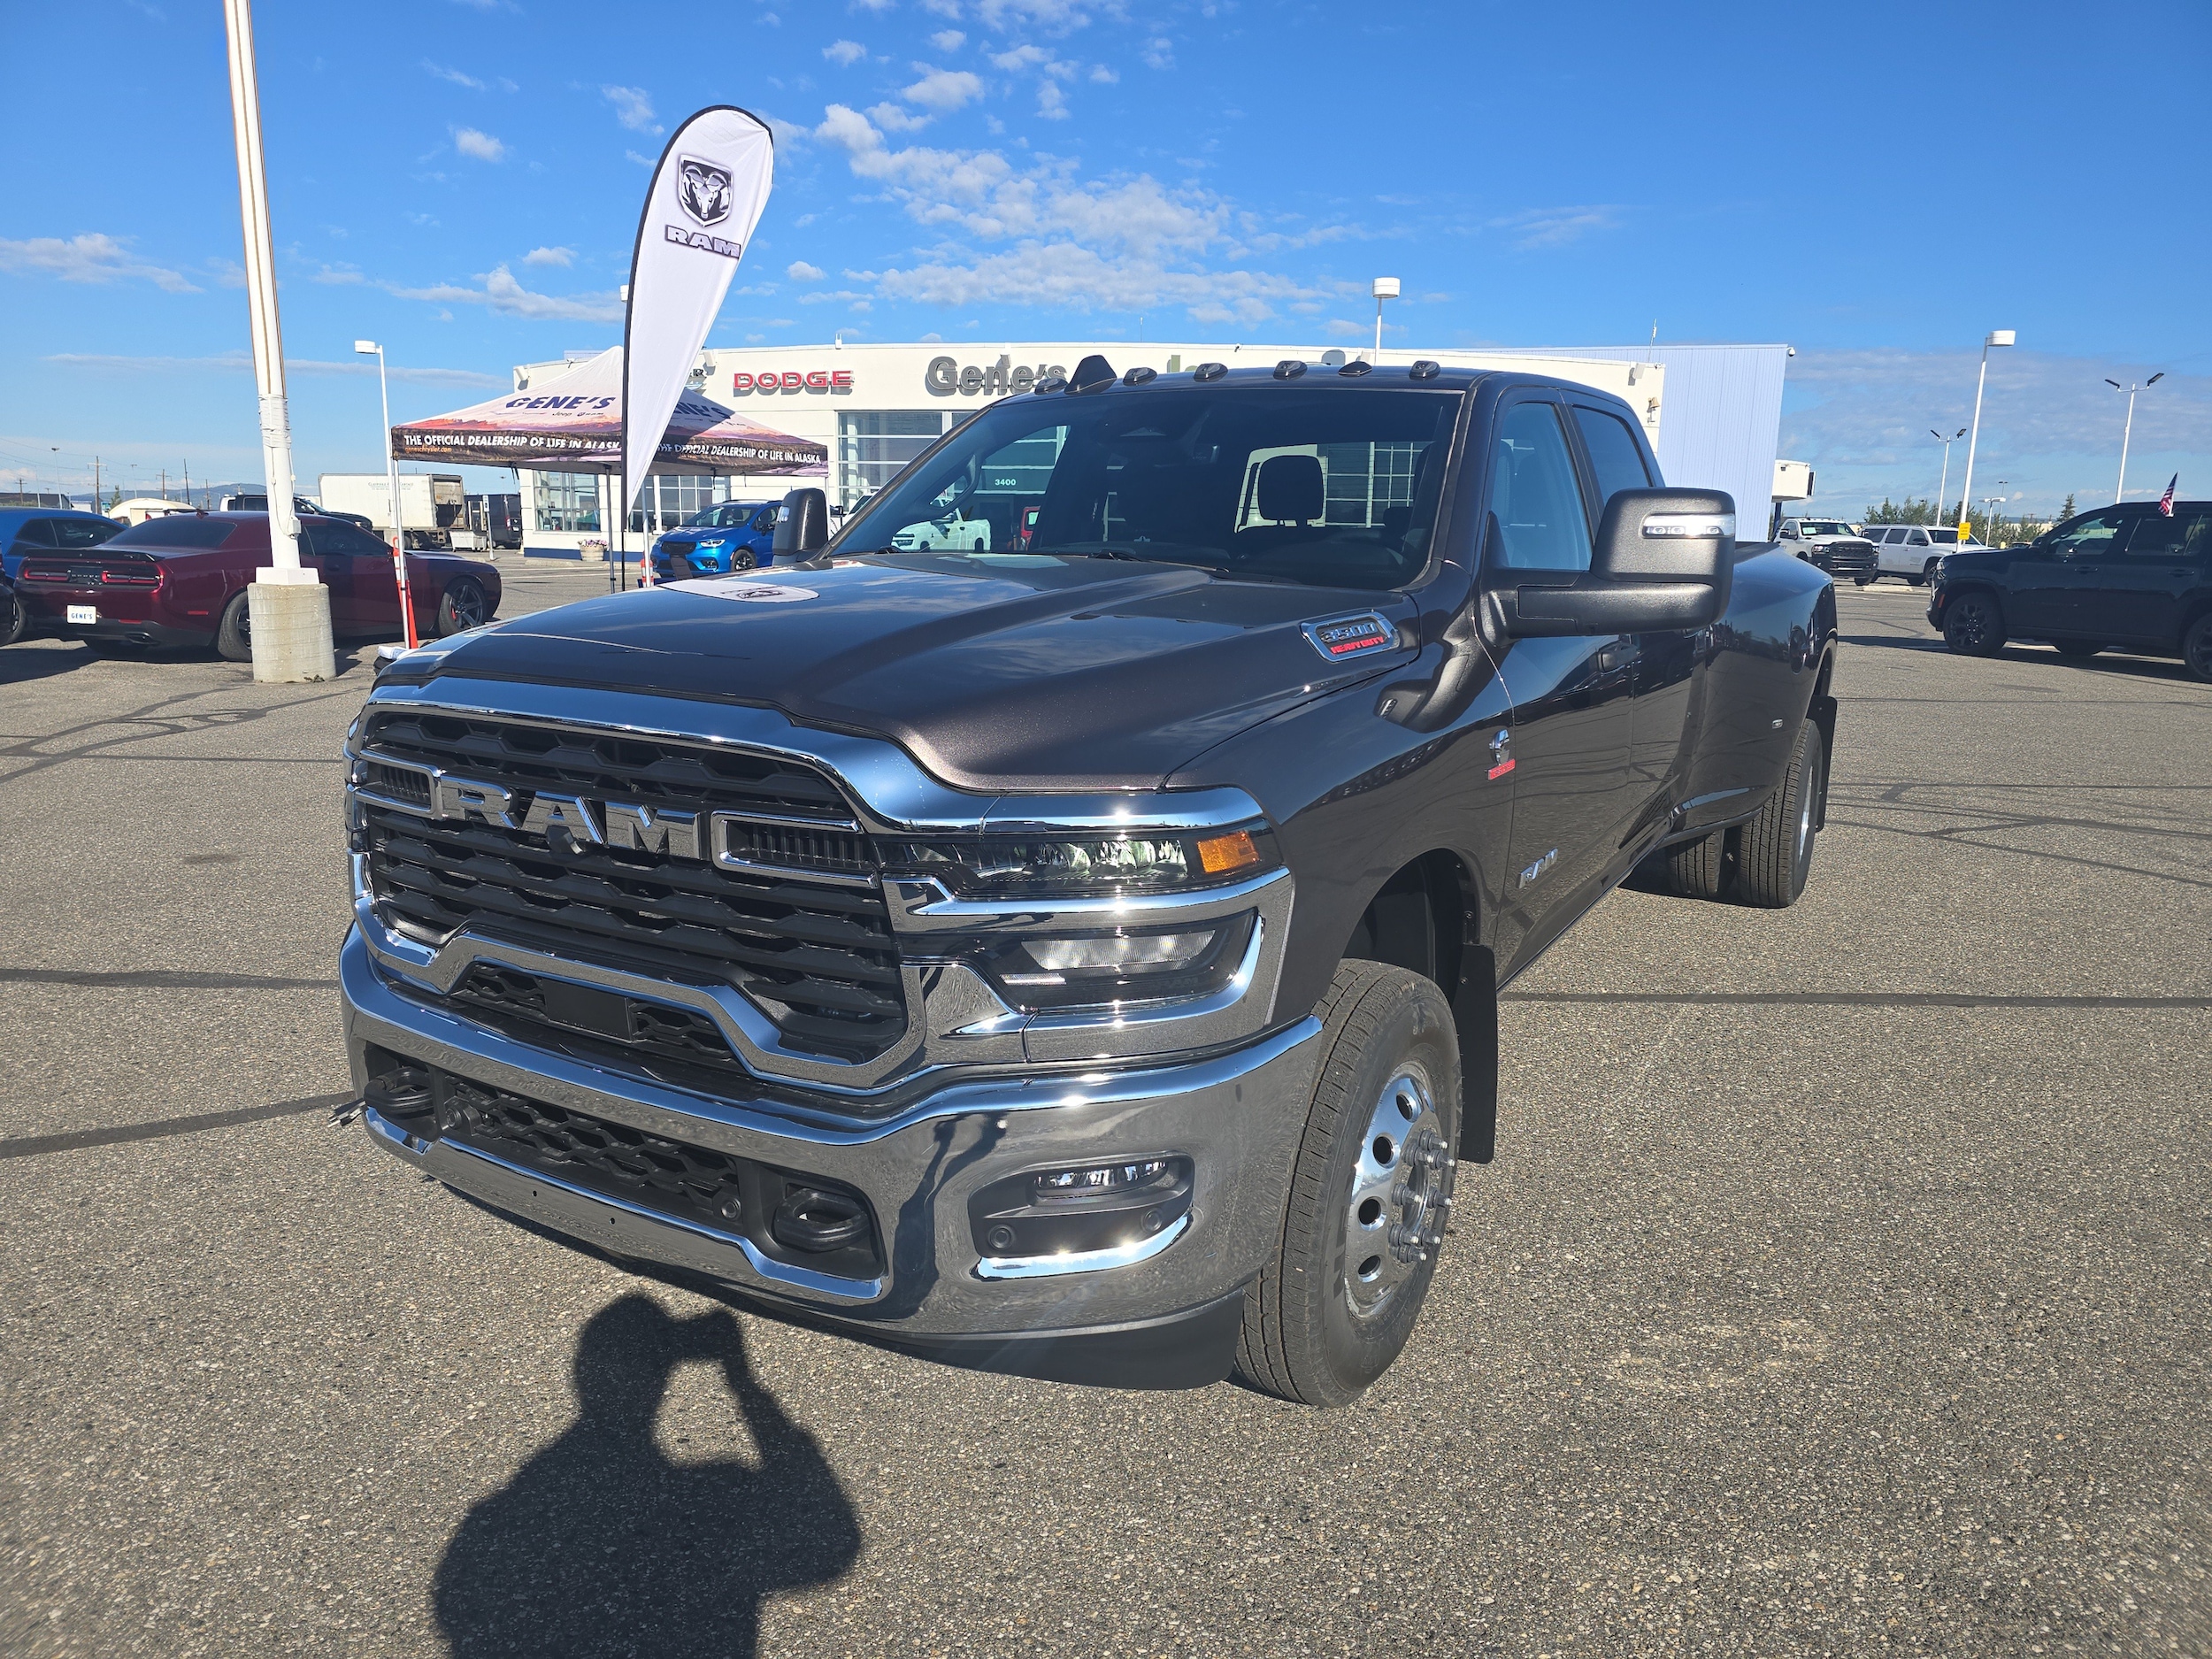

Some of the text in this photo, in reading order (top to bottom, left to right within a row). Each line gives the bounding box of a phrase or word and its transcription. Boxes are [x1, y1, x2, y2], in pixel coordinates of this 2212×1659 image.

[665, 224, 741, 258] RAM
[733, 370, 854, 389] DODGE
[506, 396, 616, 409] GENE'S
[403, 435, 423, 445] THE
[425, 435, 465, 445] OFFICIAL
[467, 436, 528, 447] DEALERSHIP
[530, 438, 545, 447] OF
[546, 438, 567, 449] LIFE
[568, 440, 582, 449] IN
[404, 444, 453, 454] geneschrysler.com
[674, 444, 710, 455] OFFICIAL
[710, 446, 757, 458] DEALERSHIP
[757, 449, 769, 459] OF
[770, 450, 784, 460] LIFE
[785, 451, 794, 461] IN
[795, 453, 821, 465] ALASKA
[1321, 622, 1378, 642] 3500
[1330, 636, 1384, 654] HEAVY DUTY
[435, 775, 705, 860] RAM
